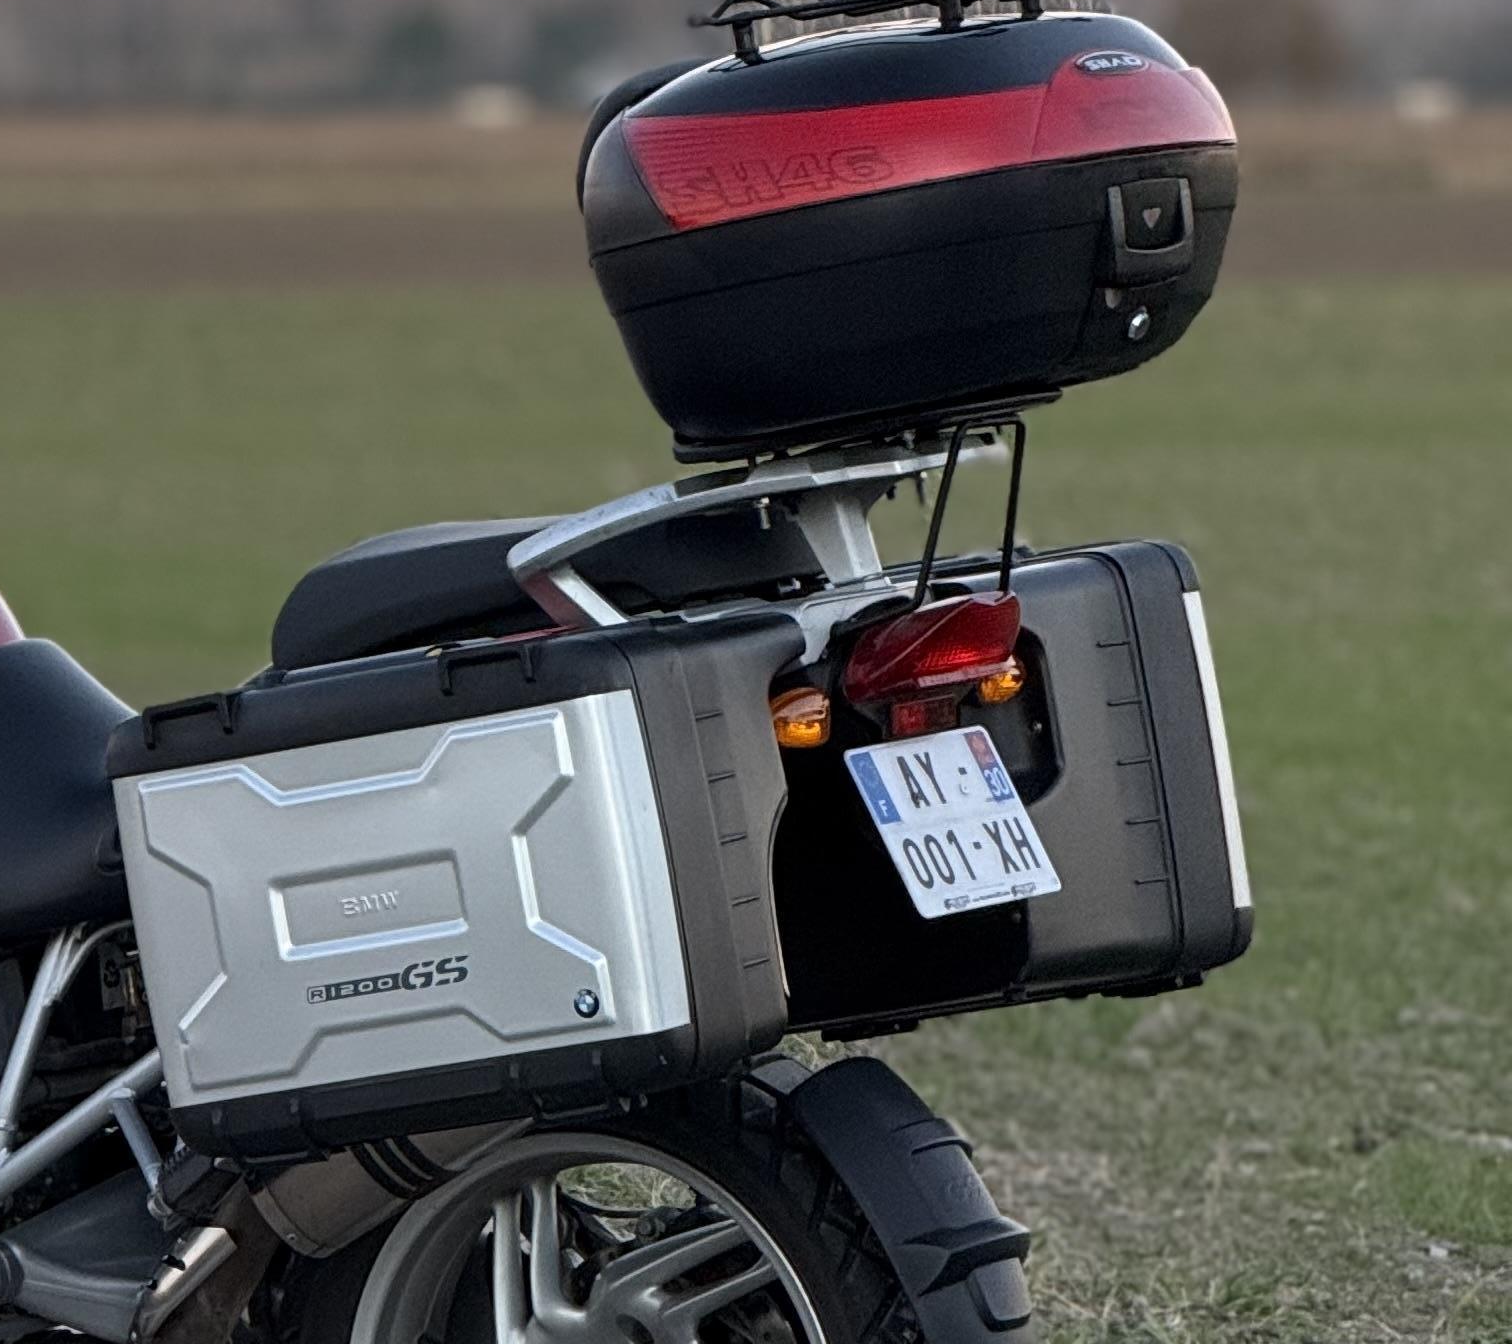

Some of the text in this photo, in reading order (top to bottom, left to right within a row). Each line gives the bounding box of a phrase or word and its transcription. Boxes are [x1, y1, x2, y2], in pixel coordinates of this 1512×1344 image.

[659, 146, 893, 216] SH46
[984, 768, 1010, 797] 30
[877, 799, 889, 817] F
[903, 816, 1041, 889] 001-XH
[341, 890, 400, 916] BMW
